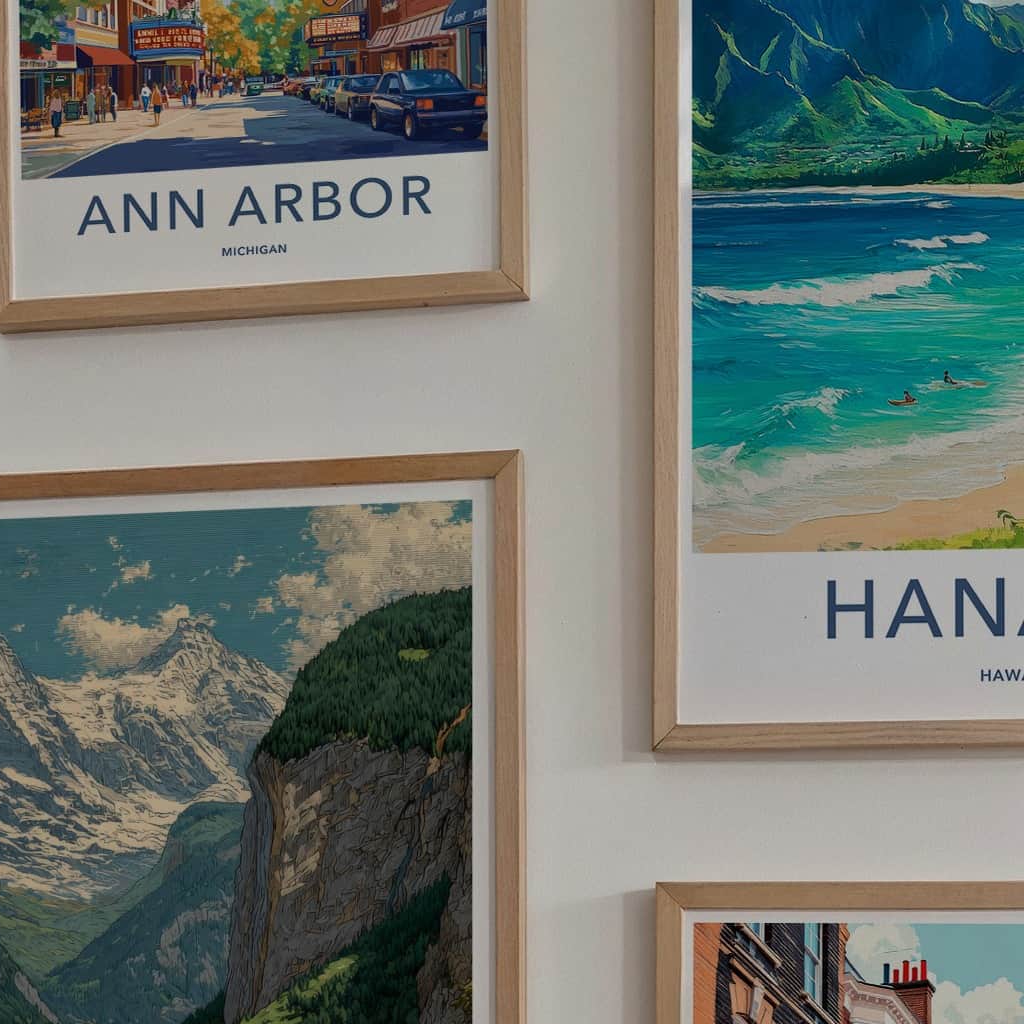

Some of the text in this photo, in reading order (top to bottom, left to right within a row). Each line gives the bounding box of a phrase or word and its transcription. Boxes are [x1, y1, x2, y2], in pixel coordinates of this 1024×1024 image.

[77, 175, 432, 236] ANN ARBOR
[221, 243, 288, 257] MICHIGAN
[826, 577, 1024, 639] HAN
